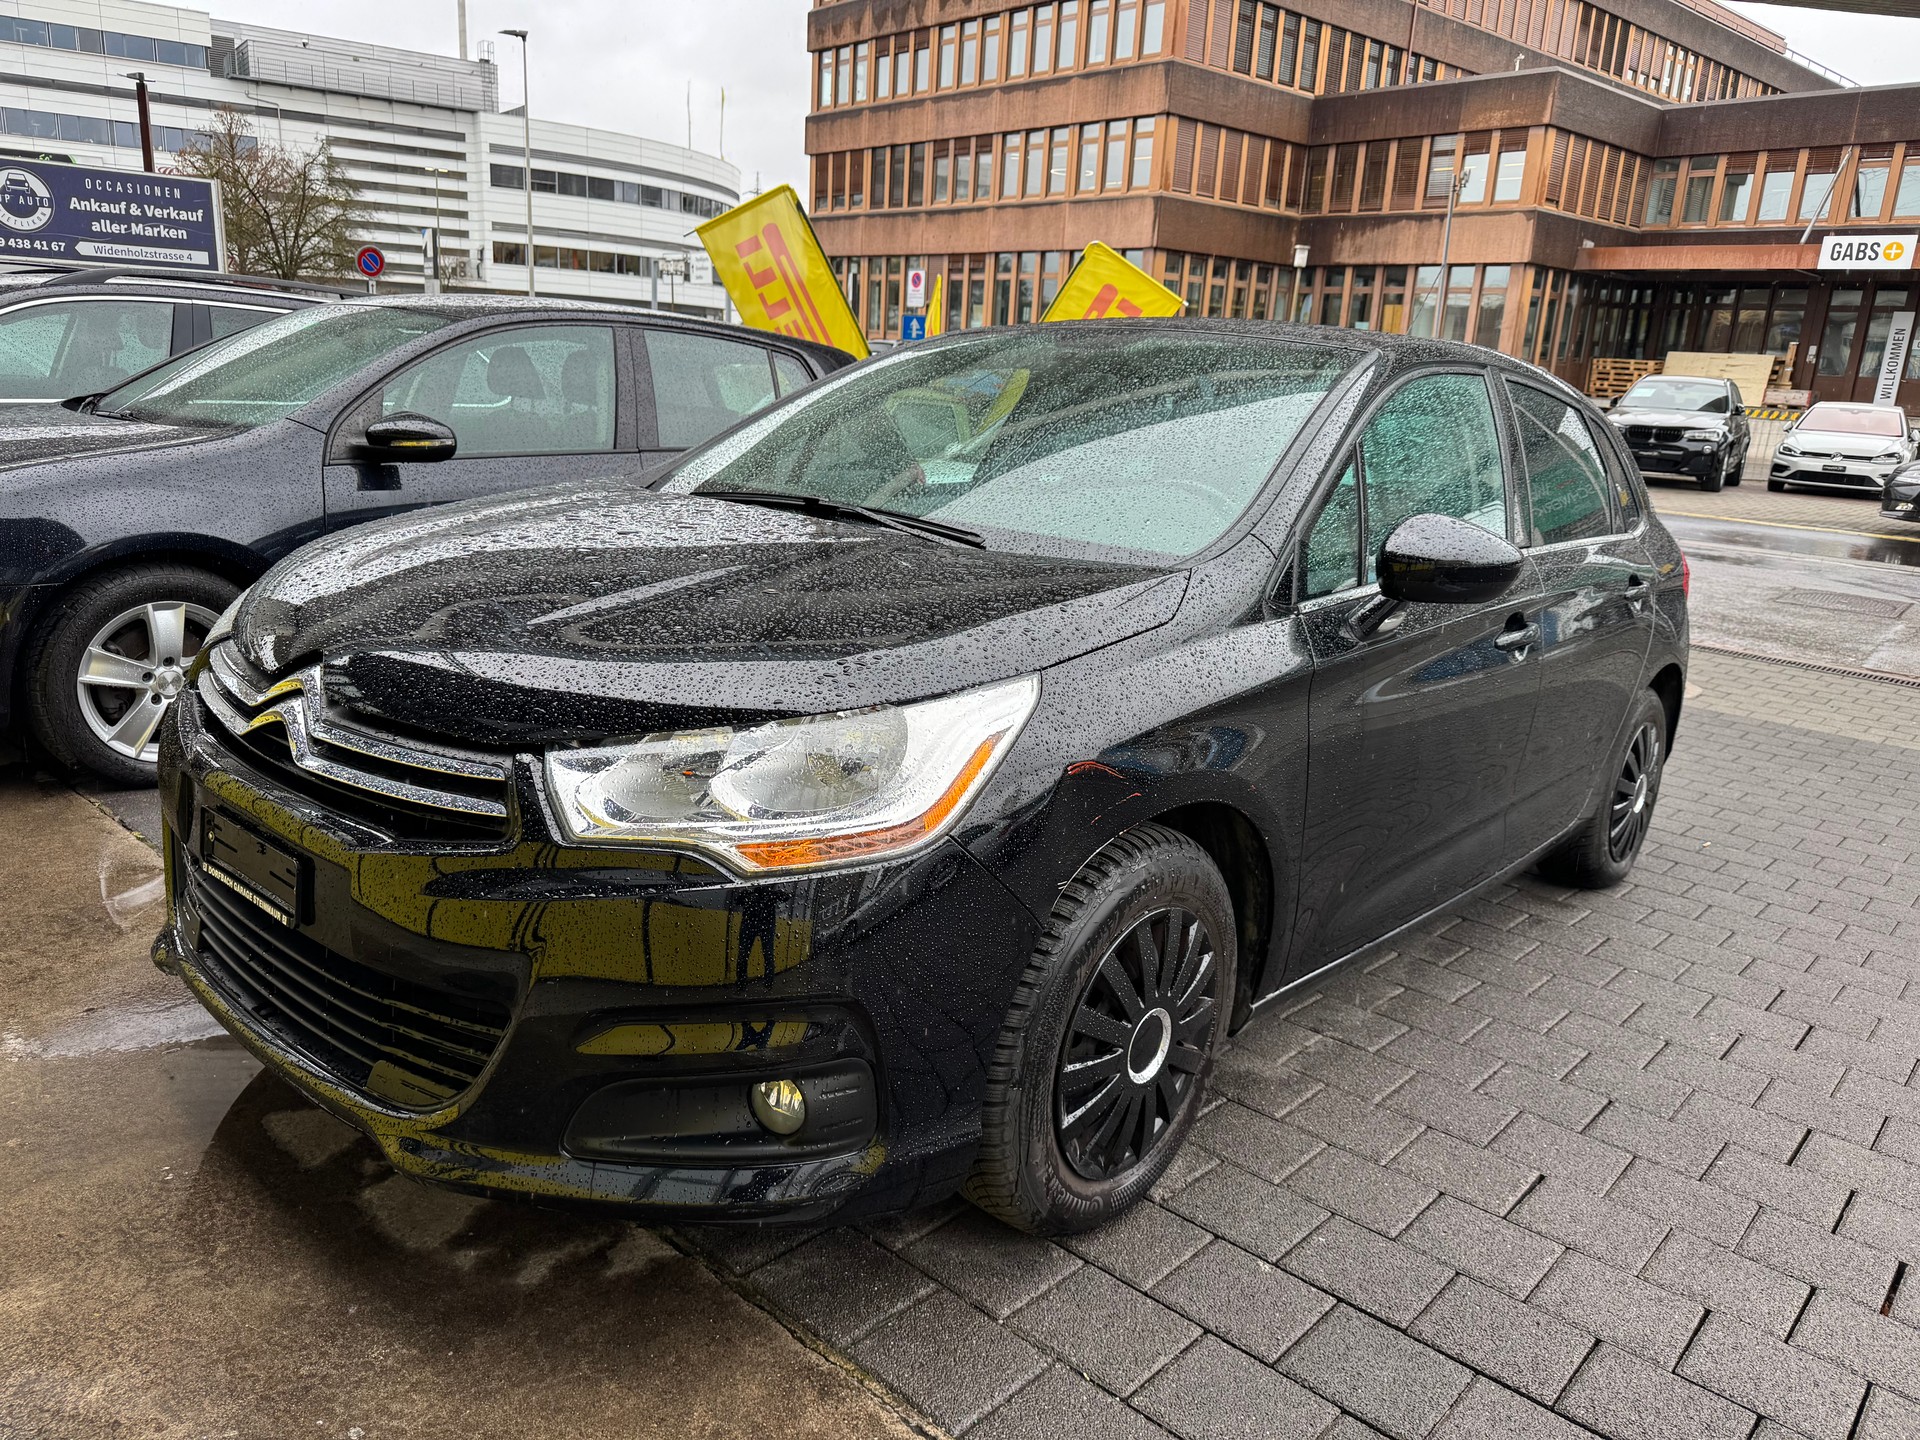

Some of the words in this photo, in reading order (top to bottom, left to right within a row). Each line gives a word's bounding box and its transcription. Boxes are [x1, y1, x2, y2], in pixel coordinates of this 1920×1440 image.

[85, 178, 181, 199] OCCASIONEN
[19, 195, 49, 207] AUTO
[69, 197, 126, 215] Ankauf
[129, 203, 142, 216] &
[144, 204, 203, 222] Verkauf
[91, 219, 128, 235] aller
[131, 222, 188, 240] Marken
[8, 238, 31, 249] 438
[33, 241, 49, 250] 41
[51, 242, 66, 252] 67
[93, 245, 185, 261] Widenholzstrasse
[186, 253, 193, 261] 4
[1830, 242, 1881, 261] GABS
[1880, 328, 1906, 399] WILLKOMMEN
[233, 882, 253, 901] GARAGE
